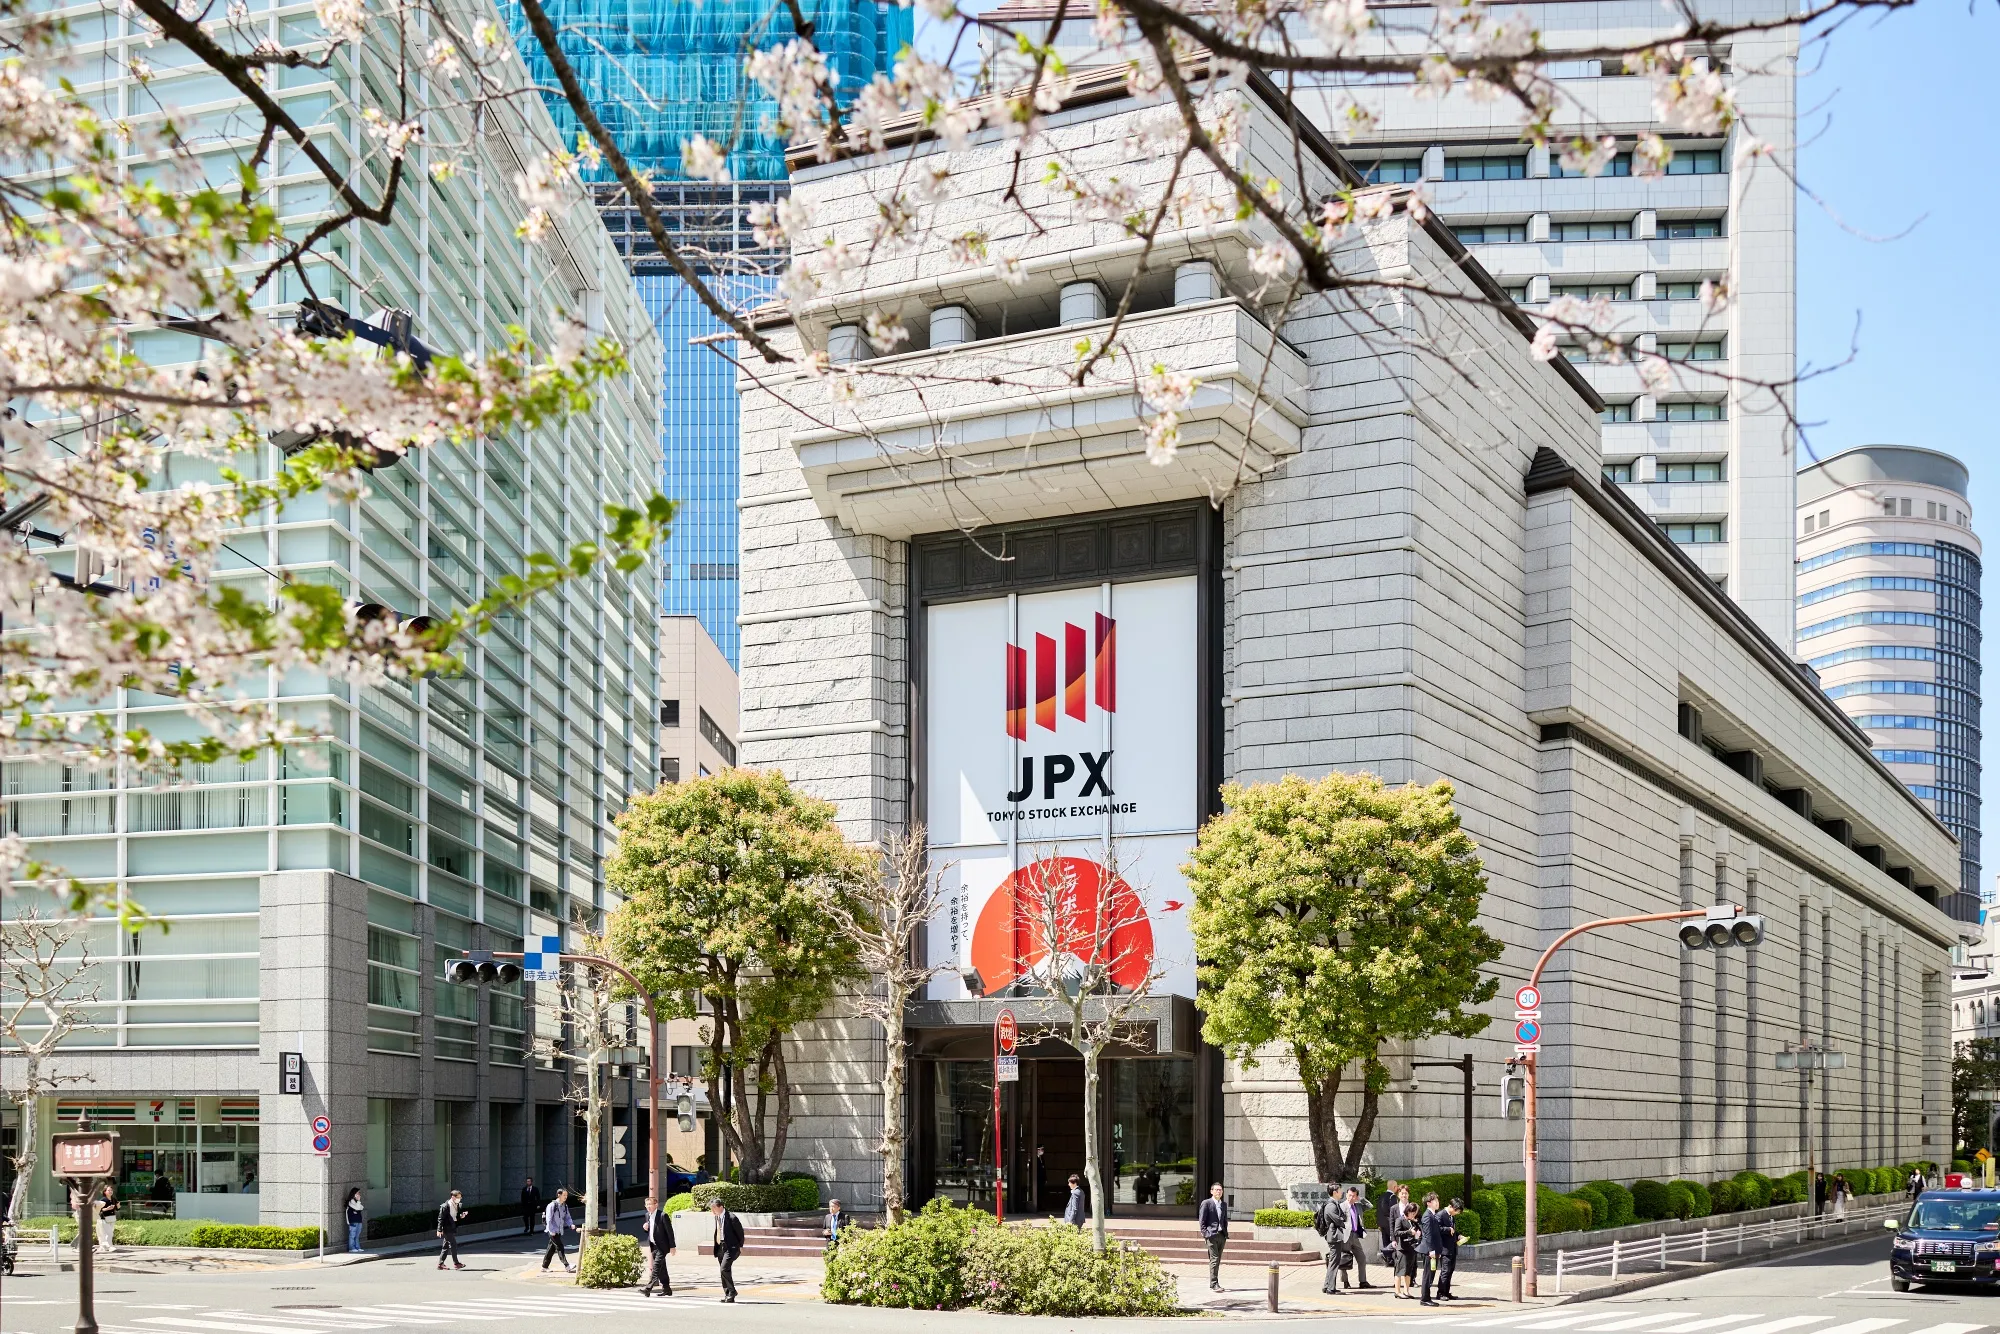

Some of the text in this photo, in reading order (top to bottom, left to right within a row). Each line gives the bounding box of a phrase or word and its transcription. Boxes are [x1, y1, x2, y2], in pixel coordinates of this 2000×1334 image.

[1007, 750, 1115, 803] JPX
[987, 802, 1137, 822] TOKYO STOCK EXCHANGE
[960, 883, 969, 941] 余裕を持って、
[524, 970, 559, 981] 時差式
[1521, 993, 1535, 1004] 30
[65, 1144, 100, 1159] 平成通り
